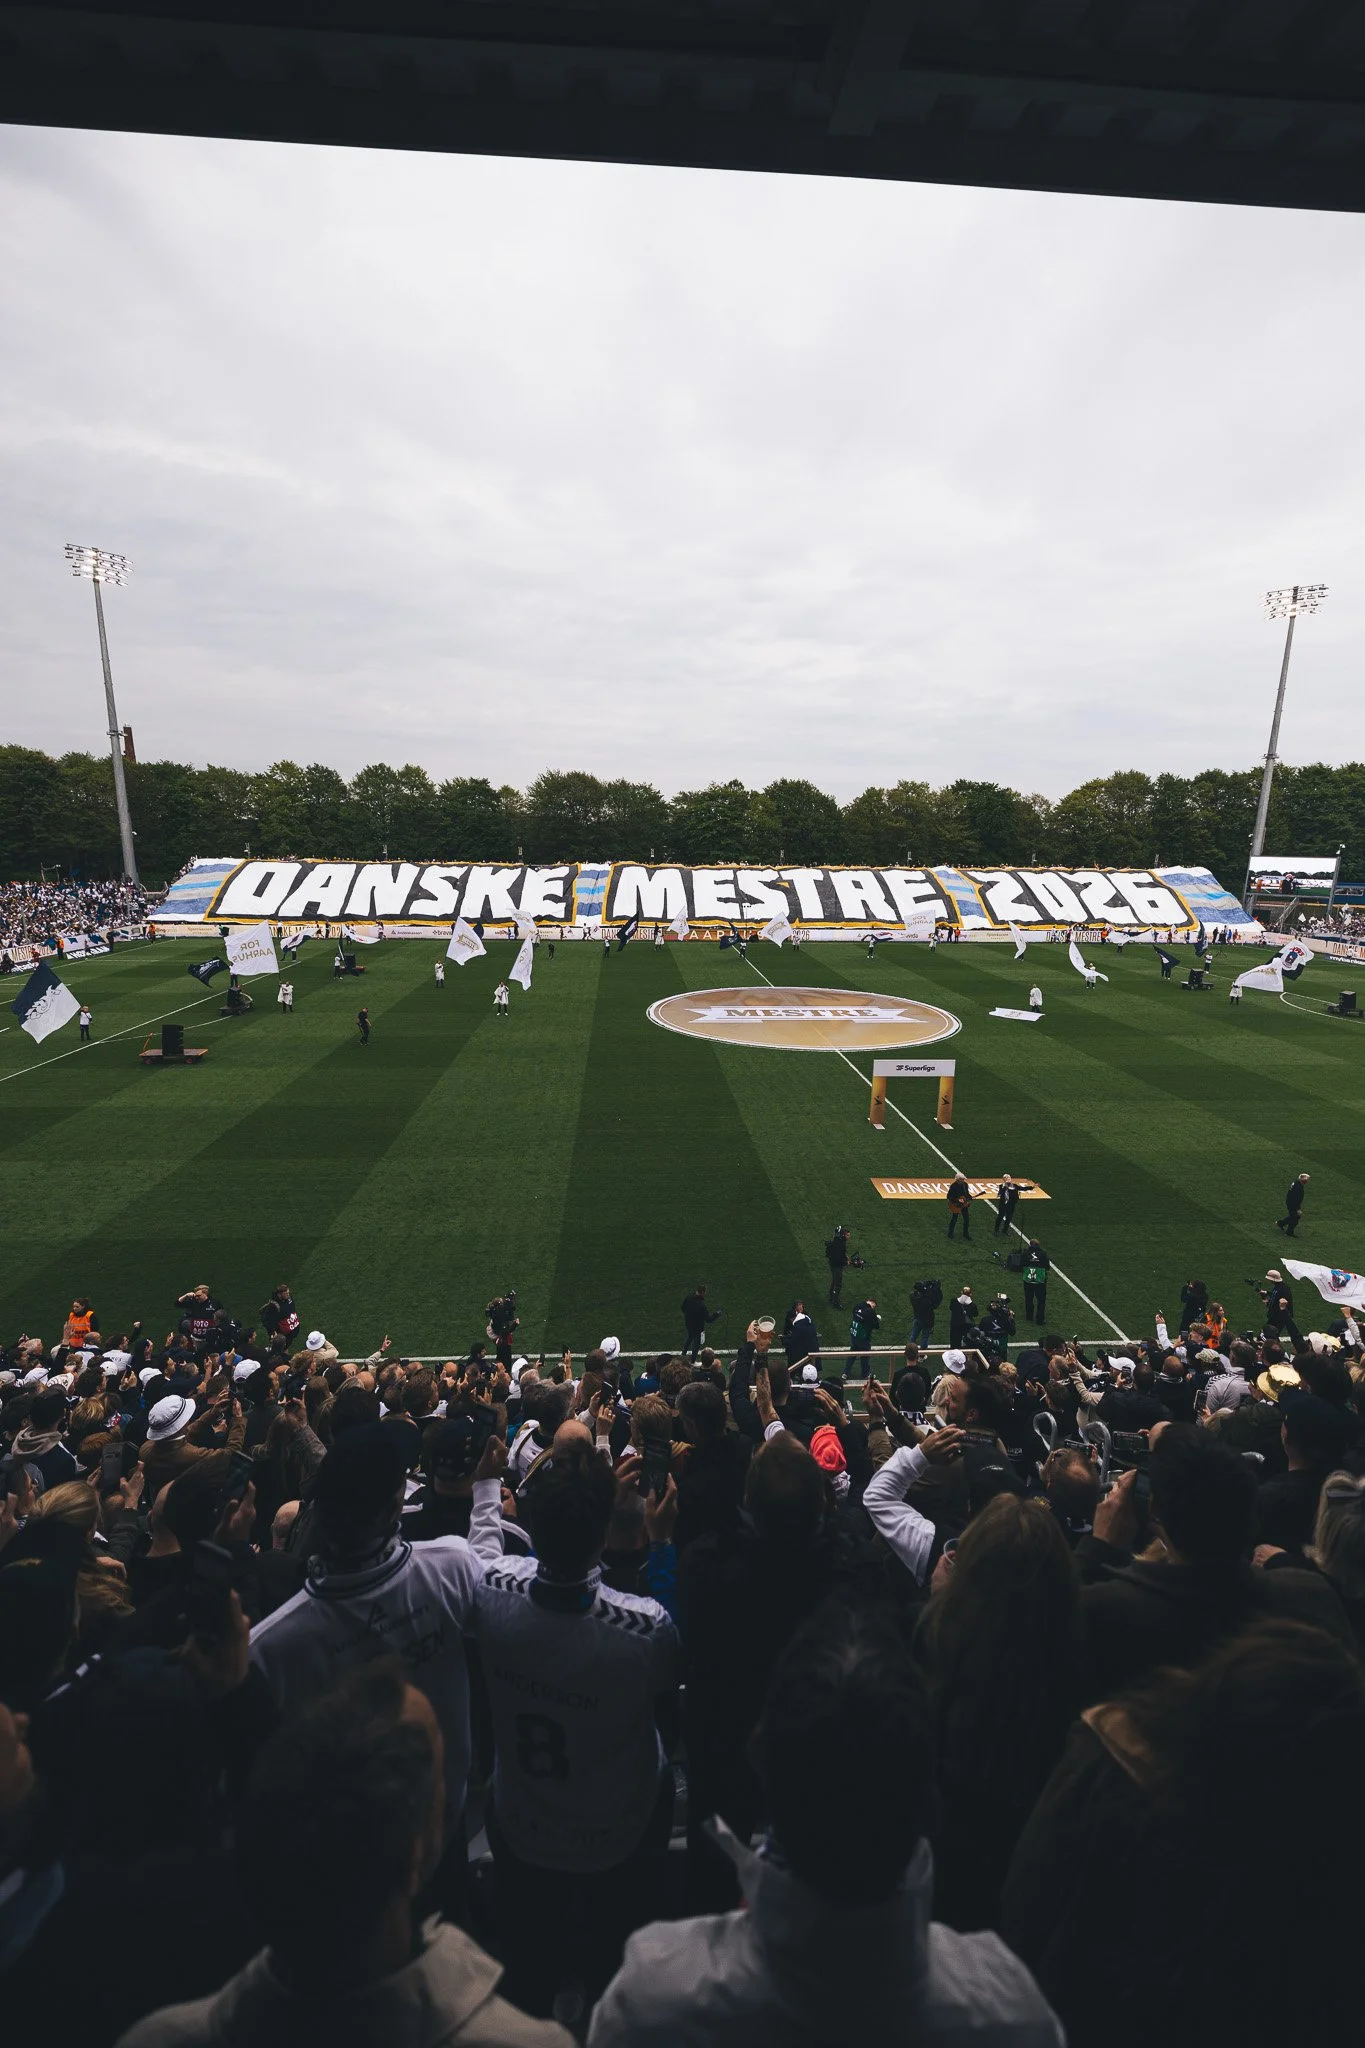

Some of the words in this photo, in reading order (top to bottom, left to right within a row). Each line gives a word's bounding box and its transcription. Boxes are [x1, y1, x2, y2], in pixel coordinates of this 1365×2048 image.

[216, 860, 570, 919] DANSKE
[612, 866, 950, 922] MESTRE
[968, 870, 1189, 925] 2026
[725, 1008, 878, 1018] MESTRE
[904, 1065, 936, 1073] Superliga
